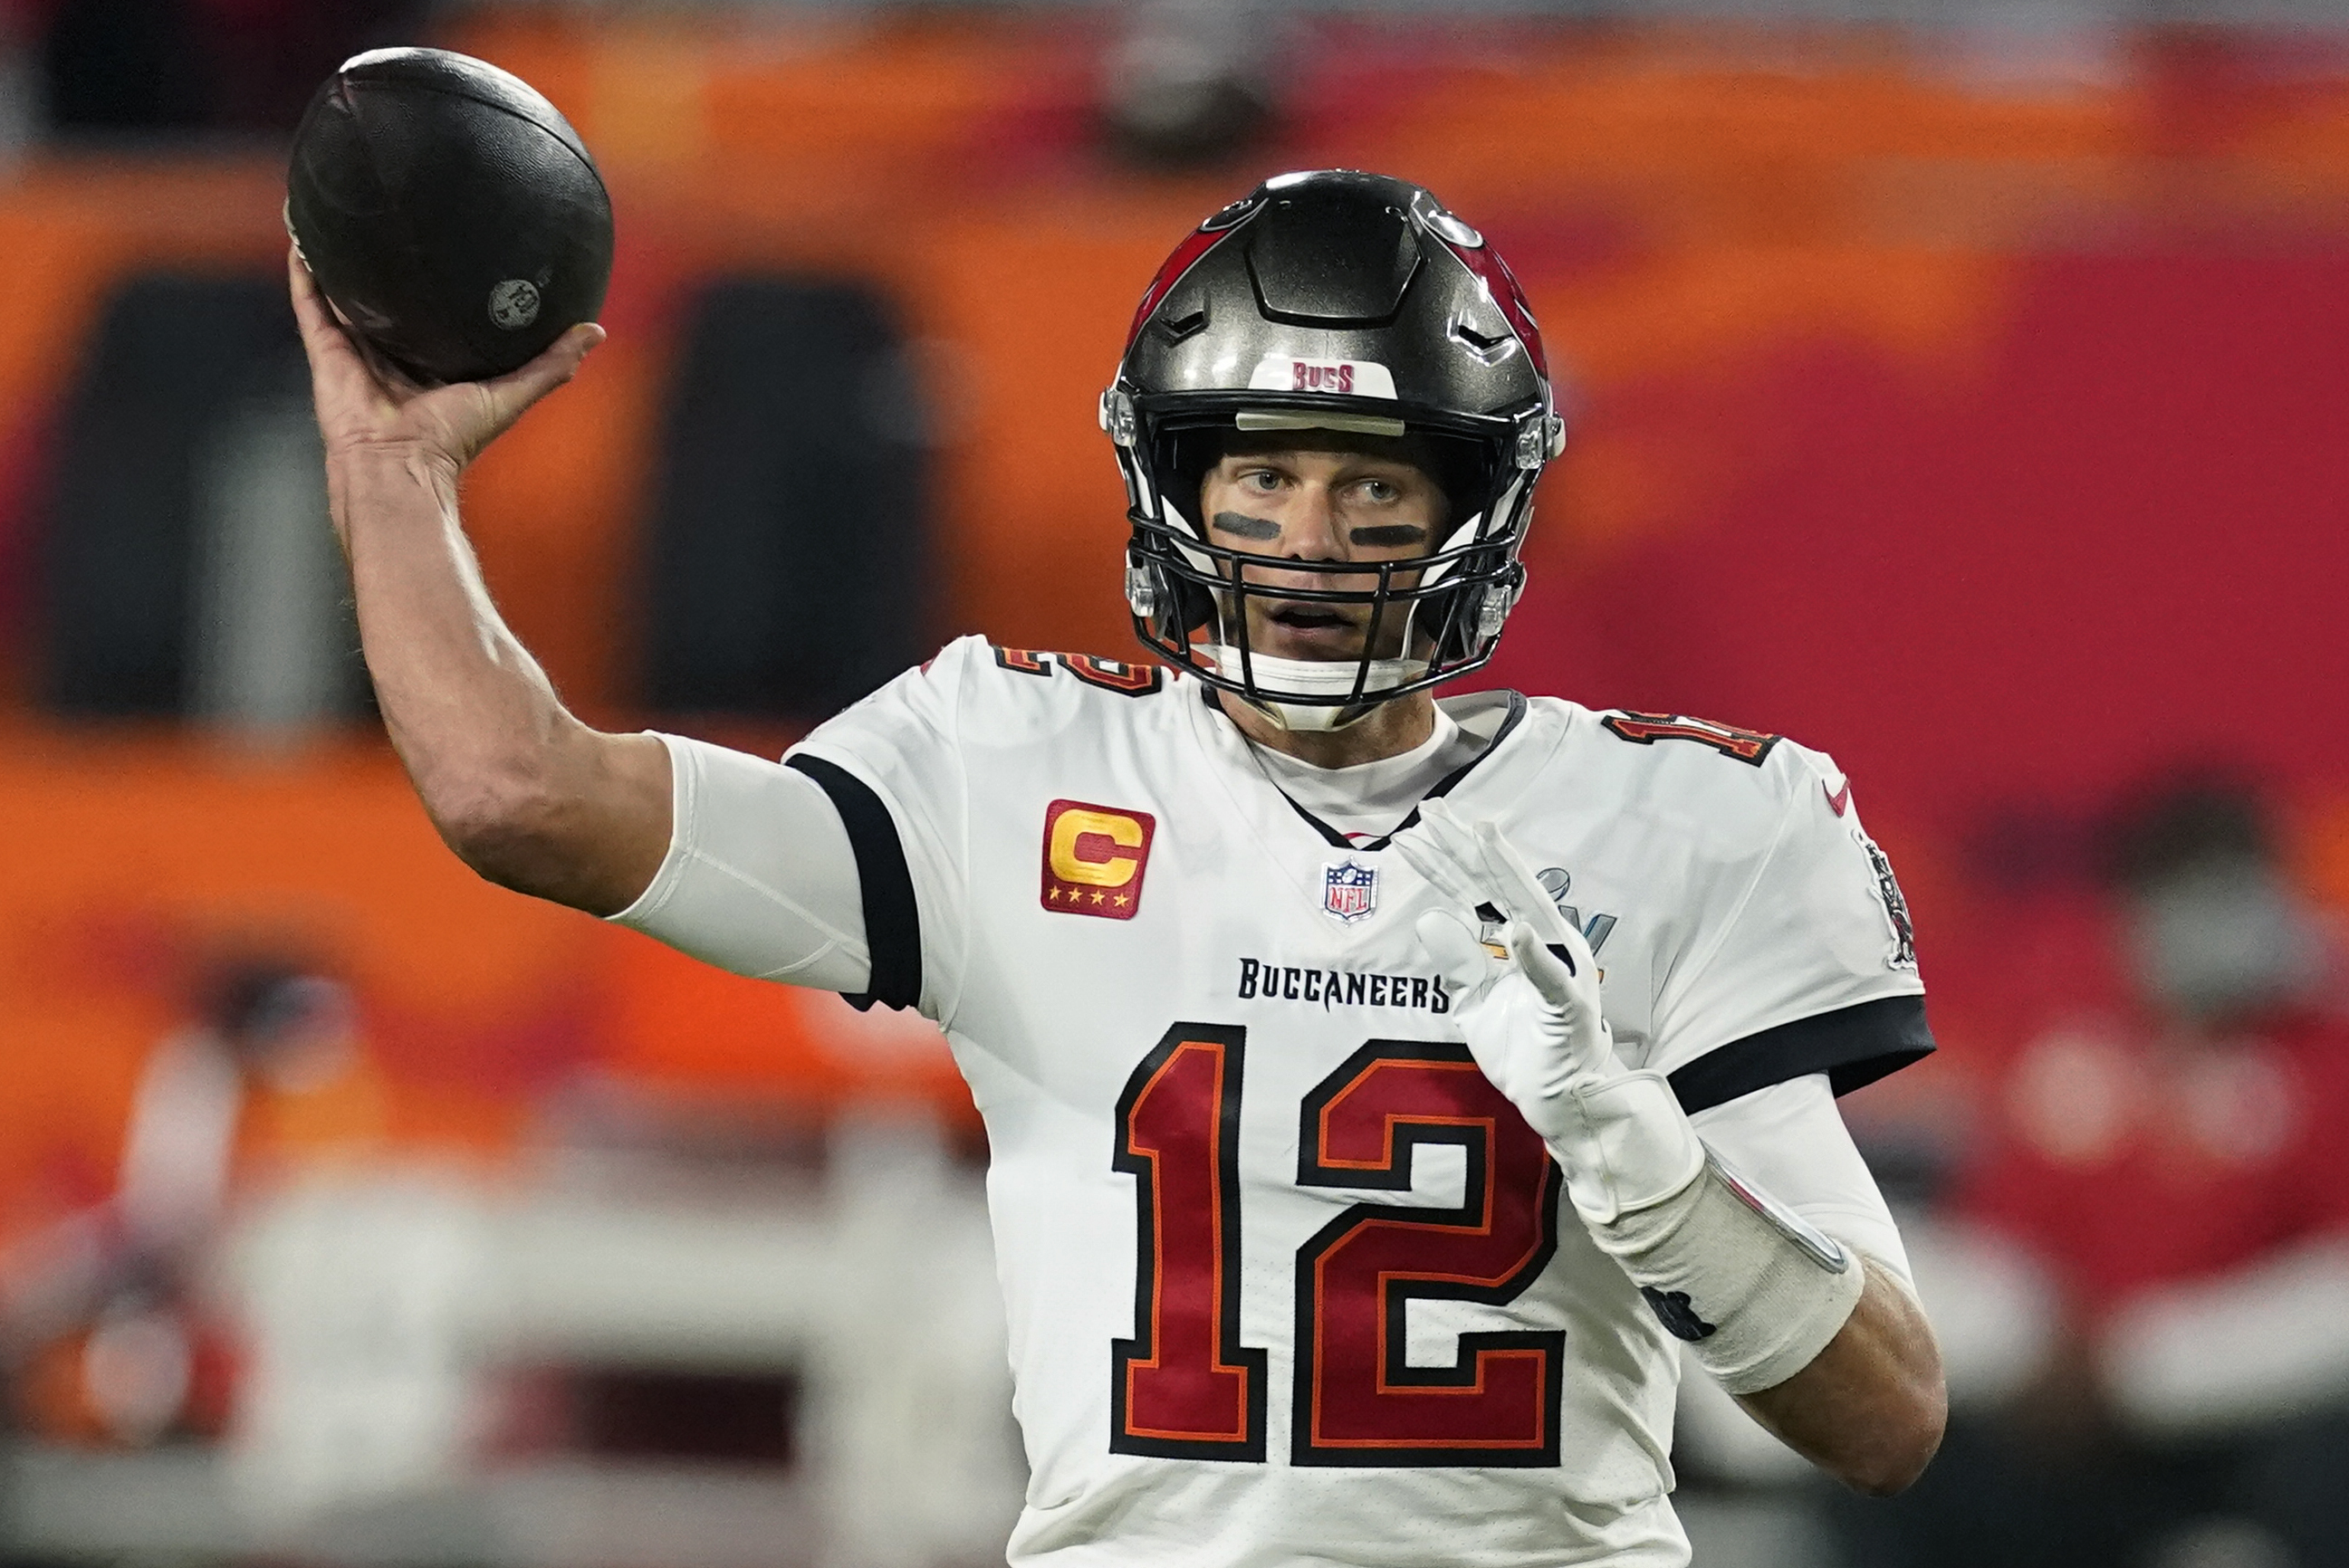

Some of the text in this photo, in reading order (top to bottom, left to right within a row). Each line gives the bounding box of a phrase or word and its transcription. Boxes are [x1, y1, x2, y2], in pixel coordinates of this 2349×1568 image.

[1292, 361, 1356, 393] BUCS
[1050, 808, 1143, 887] C
[1329, 886, 1367, 913] NFL
[1238, 958, 1449, 1014] BUCCANEERS
[1108, 1021, 1566, 1468] 12
